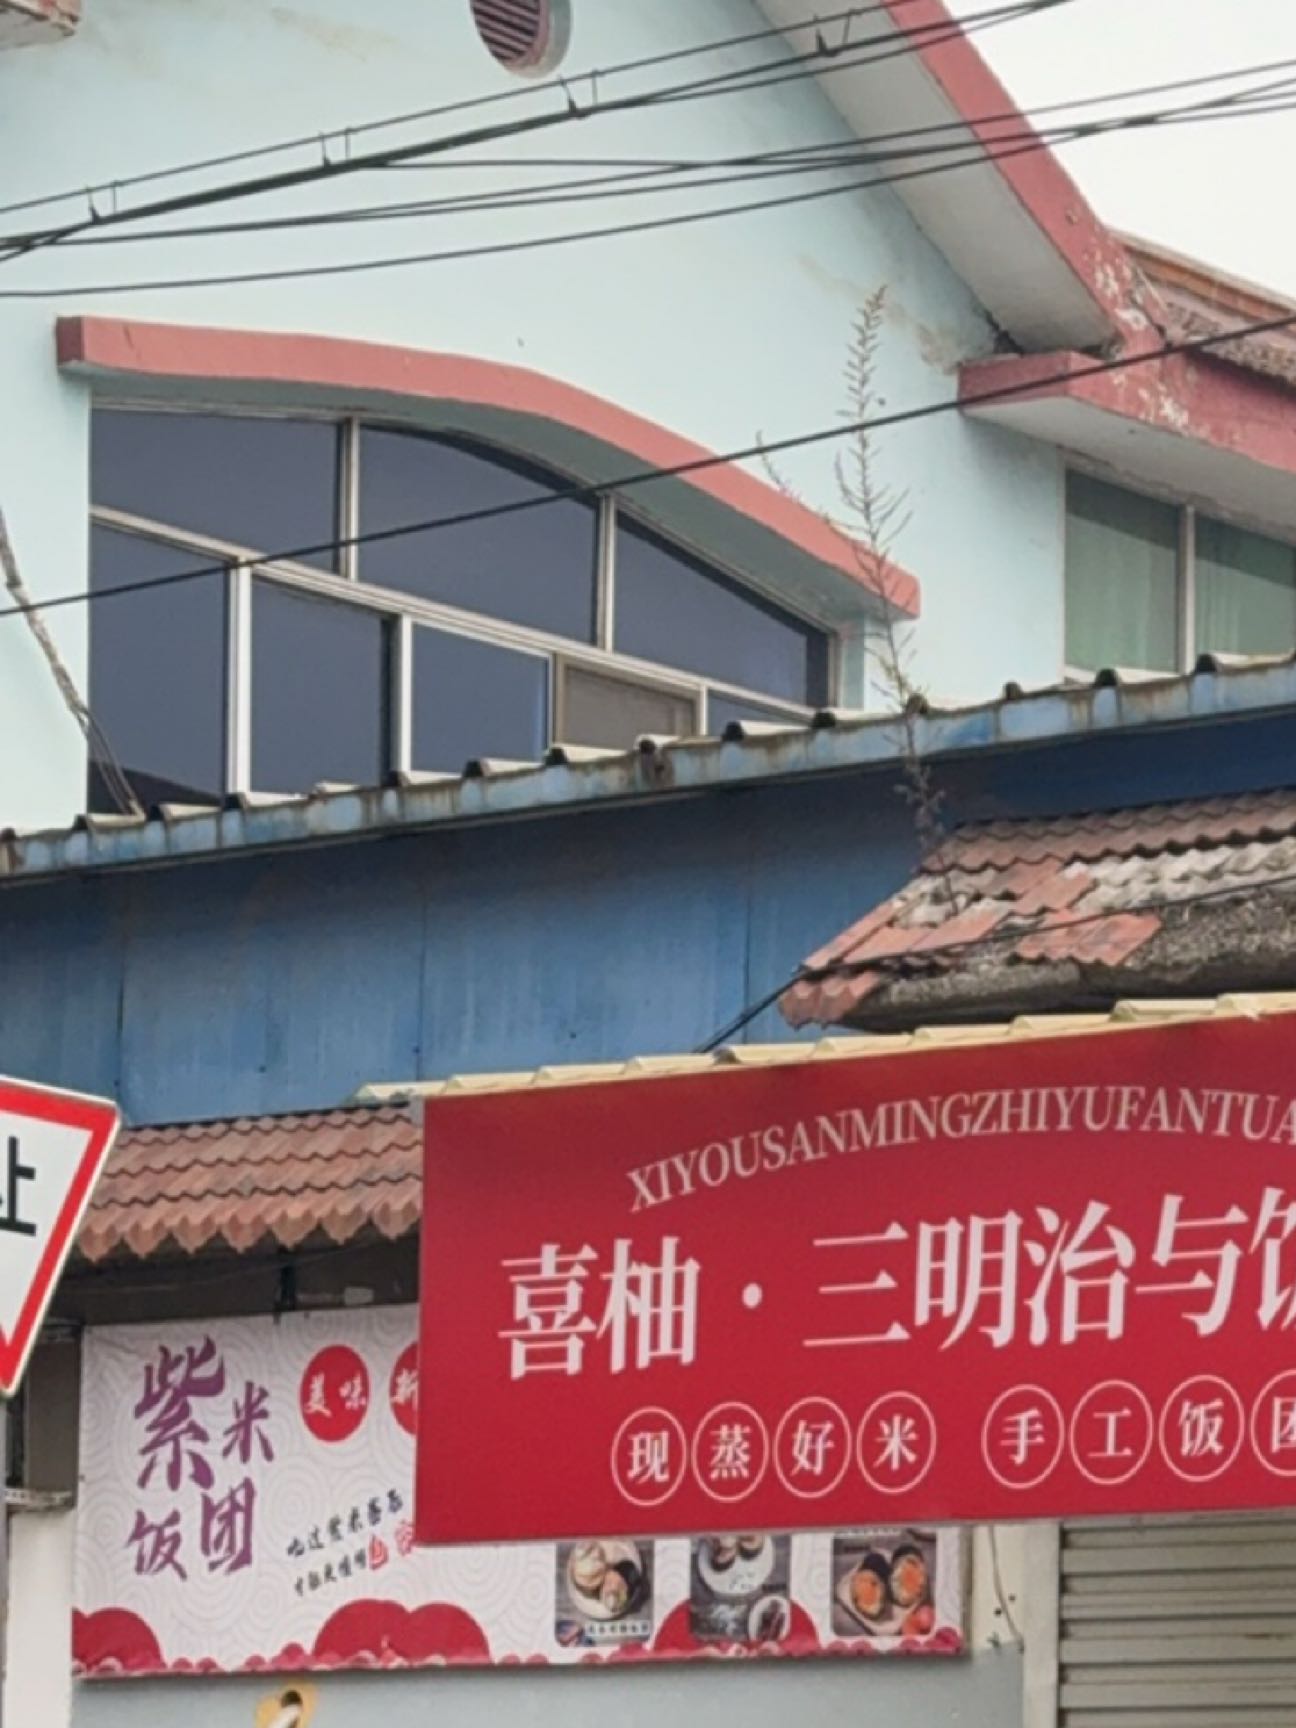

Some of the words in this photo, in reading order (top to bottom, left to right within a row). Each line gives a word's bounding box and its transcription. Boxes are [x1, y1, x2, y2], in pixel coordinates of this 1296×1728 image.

[304, 1372, 367, 1418] 美味
[626, 1412, 922, 1484] 现蒸好米
